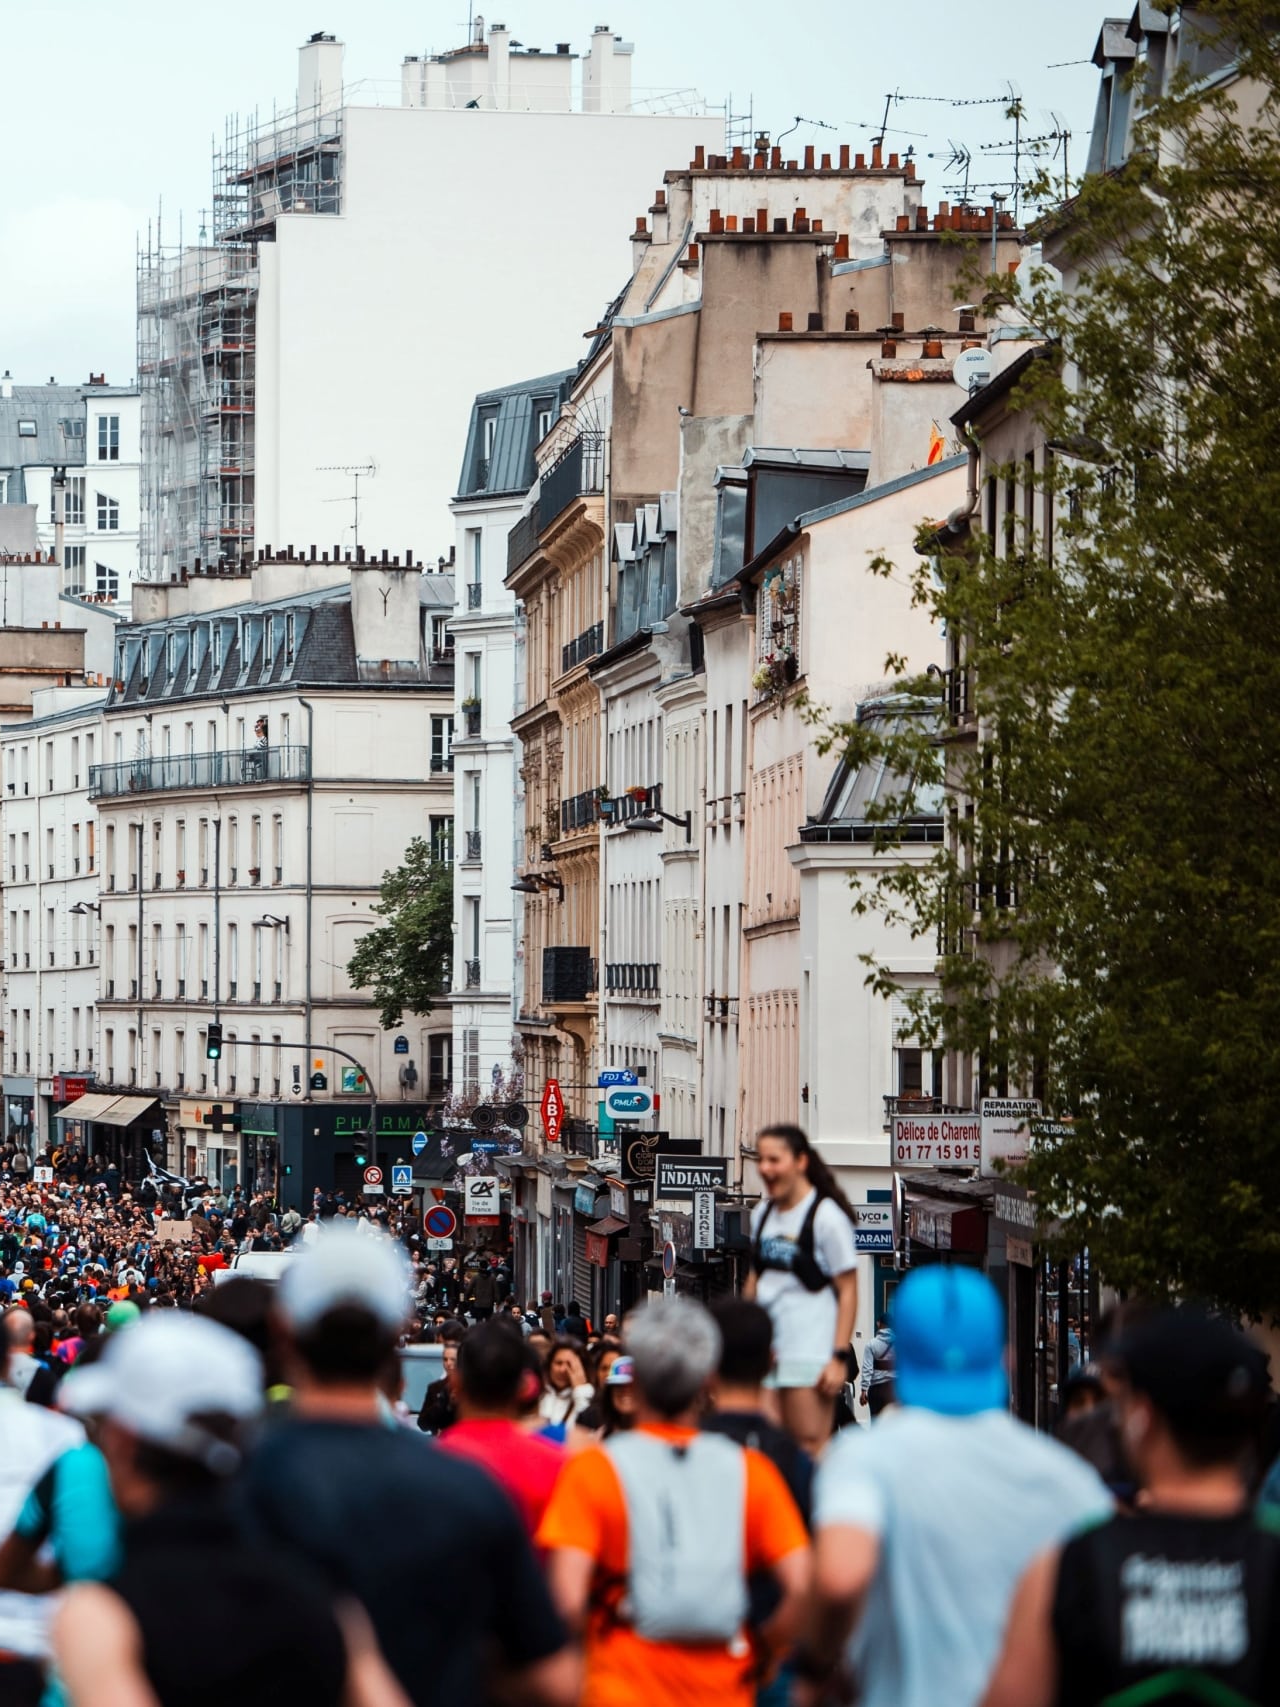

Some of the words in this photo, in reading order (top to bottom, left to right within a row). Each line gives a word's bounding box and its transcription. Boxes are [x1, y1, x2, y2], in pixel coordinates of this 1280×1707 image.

[547, 1085, 558, 1136] TABAC
[984, 1101, 1038, 1110] REPARATION
[897, 1121, 925, 1141] Délice
[927, 1122, 939, 1141] de
[897, 1145, 912, 1160] 01
[916, 1145, 931, 1160] 77
[936, 1145, 951, 1160] 15
[954, 1145, 969, 1160] 91
[973, 1145, 980, 1160] 5
[661, 1171, 711, 1185] INDIAN
[699, 1193, 710, 1247] ASSURANCES
[856, 1212, 881, 1222] Lyca
